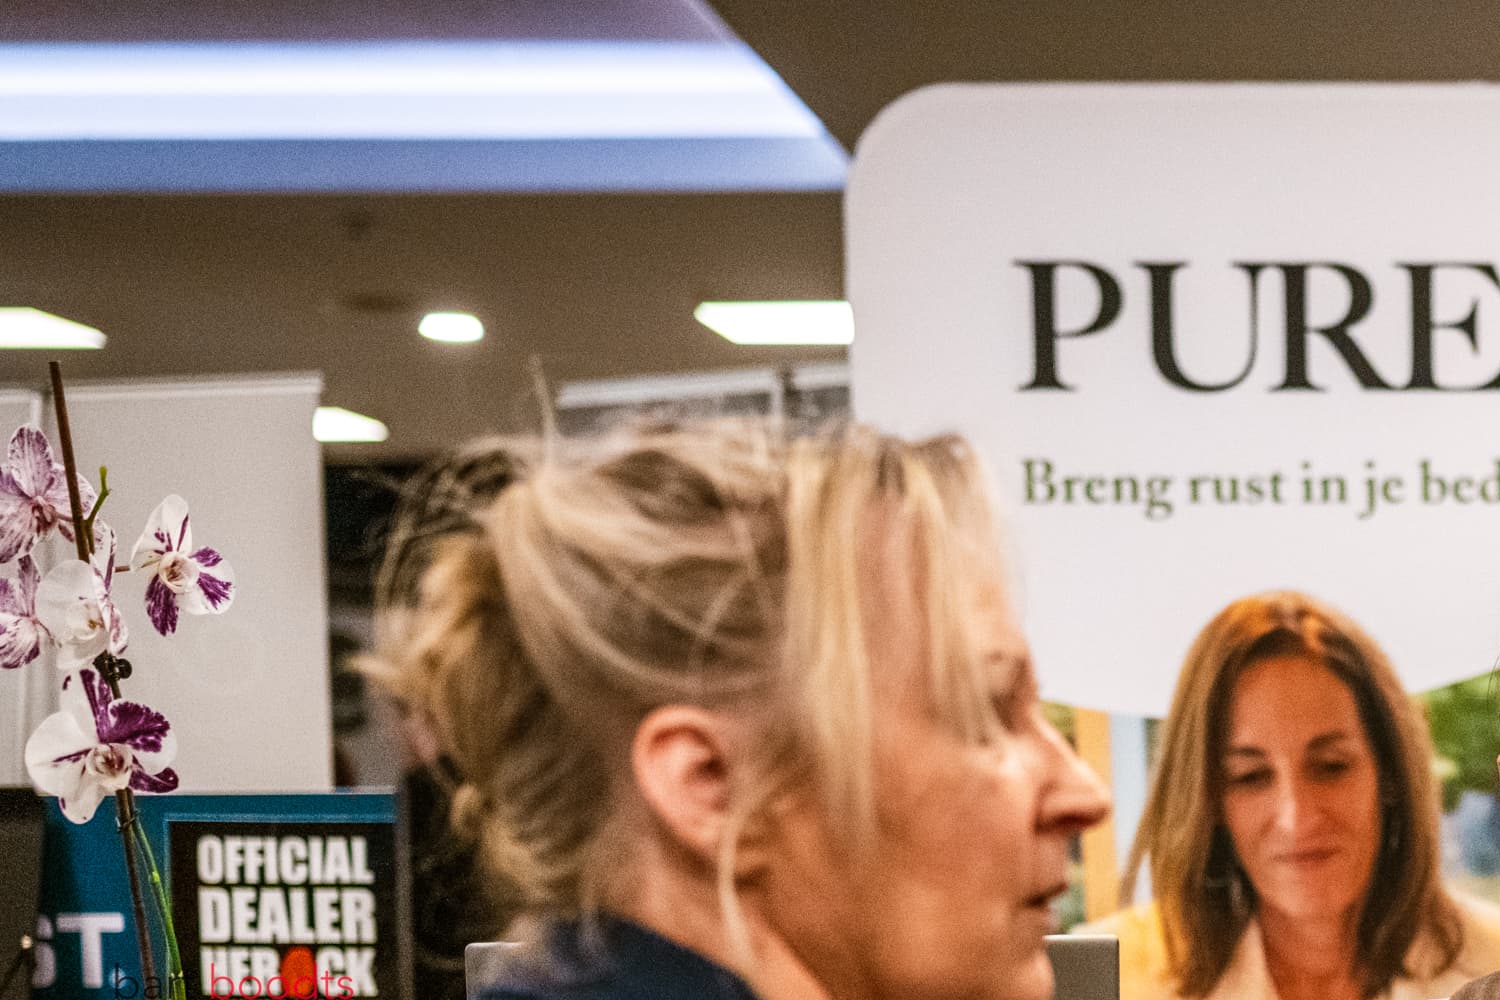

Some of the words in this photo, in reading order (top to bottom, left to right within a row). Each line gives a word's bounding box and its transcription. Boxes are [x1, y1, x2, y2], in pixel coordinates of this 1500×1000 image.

[1021, 458, 1173, 518] Breng
[1189, 470, 1287, 505] rust
[1302, 460, 1349, 505] in
[1359, 460, 1404, 518] je
[197, 836, 375, 885] OFFICIAL
[200, 887, 378, 944] DEALER
